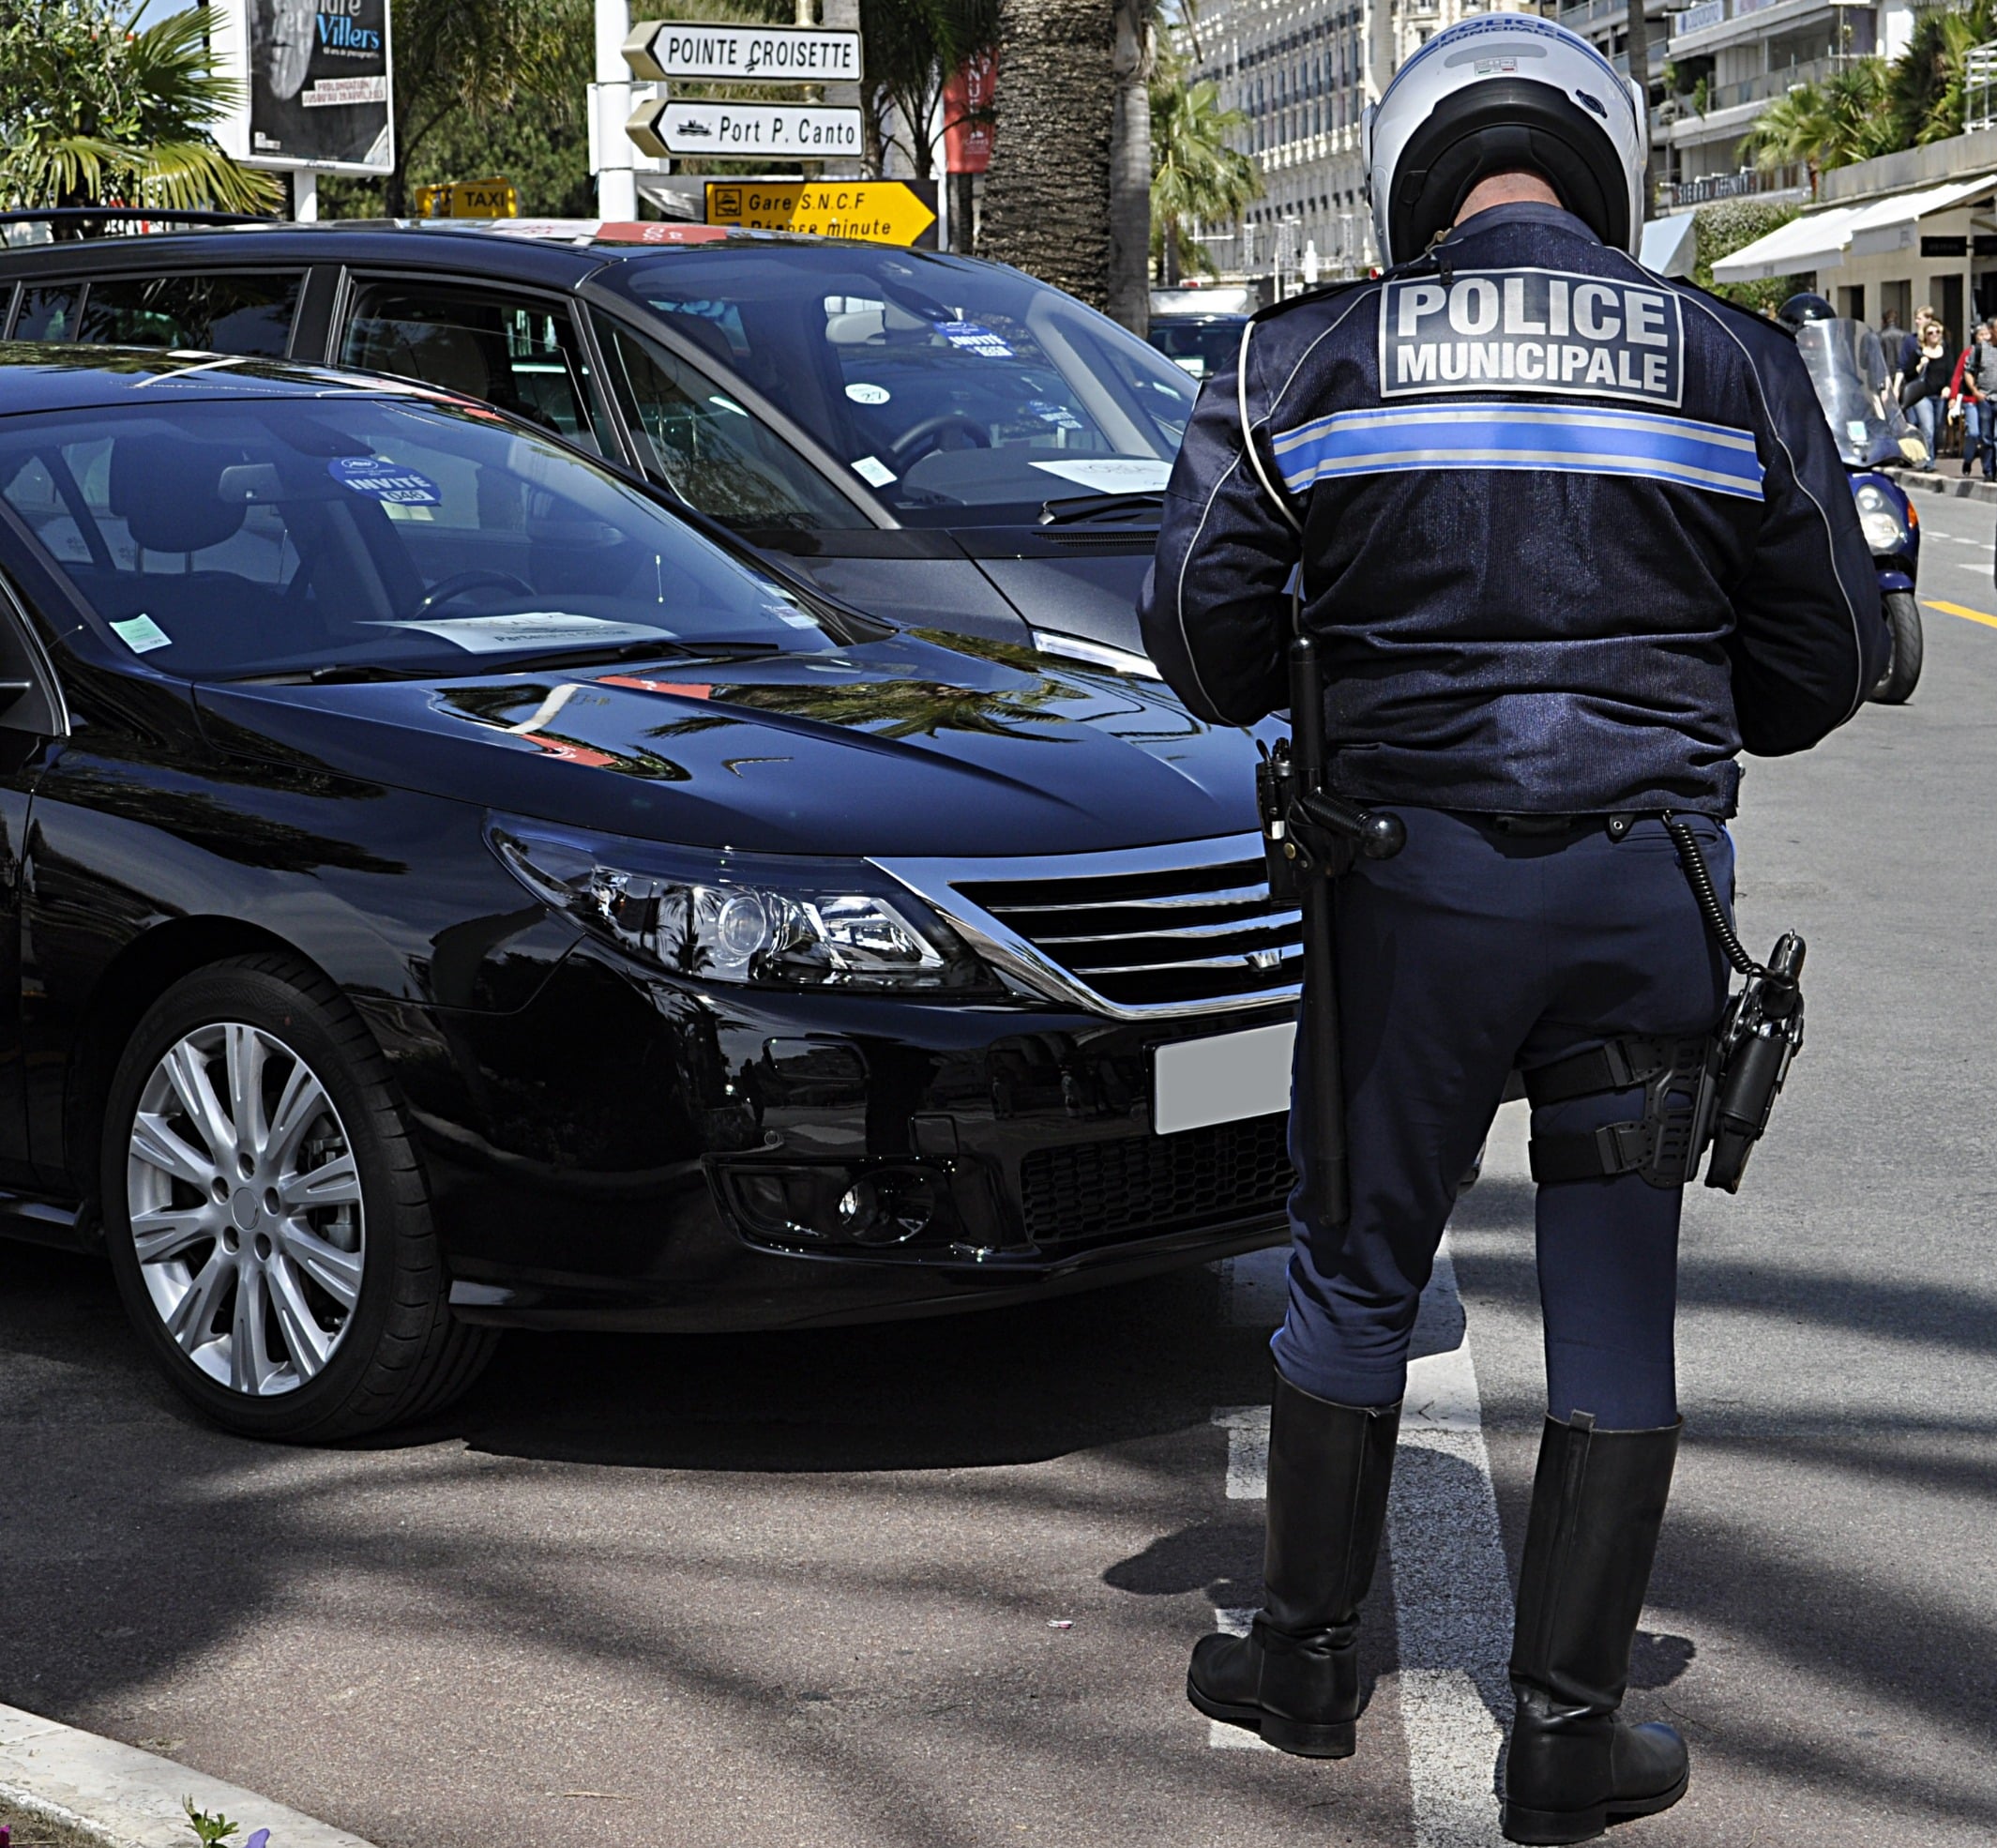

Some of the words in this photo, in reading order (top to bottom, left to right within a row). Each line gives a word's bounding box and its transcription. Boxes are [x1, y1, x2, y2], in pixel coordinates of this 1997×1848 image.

[316, 13, 380, 49] Villers
[1440, 19, 1555, 40] POLICE
[1440, 26, 1555, 48] MUNICIPALE
[668, 38, 737, 65] POINTE
[749, 40, 852, 68] CROISETTE
[719, 115, 761, 142] Port
[771, 117, 789, 144] P.
[798, 118, 855, 144] Canto
[464, 191, 506, 207] TAXI
[749, 193, 792, 210] Gare
[826, 219, 891, 236] minute
[1397, 278, 1669, 347] POLICE
[1397, 341, 1668, 392] MUNICIPALE
[344, 475, 431, 490] INVITÉ
